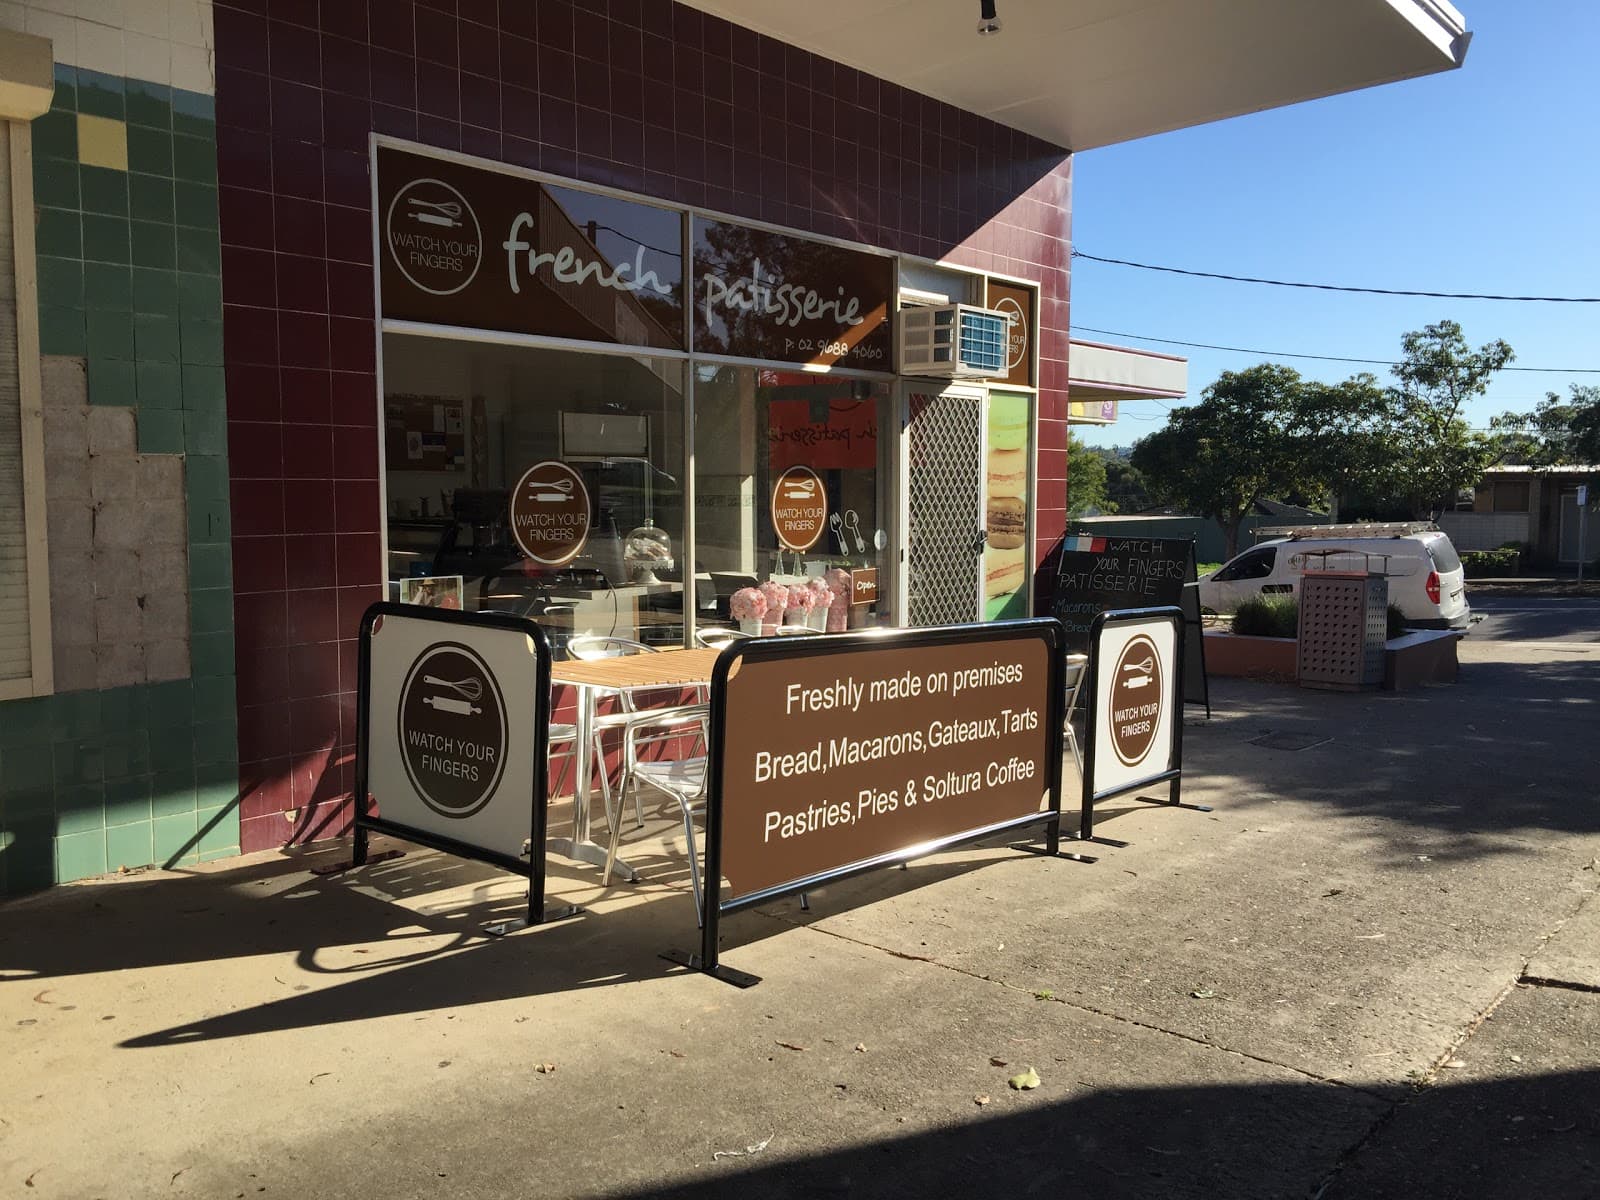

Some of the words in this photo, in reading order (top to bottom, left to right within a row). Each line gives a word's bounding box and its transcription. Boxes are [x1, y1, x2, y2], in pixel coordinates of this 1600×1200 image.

[393, 232, 440, 250] WATCH
[441, 238, 478, 258] YOUR
[410, 251, 464, 272] FINGERS
[503, 212, 672, 294] french
[702, 257, 864, 327] patisserie
[798, 338, 814, 350] 02
[818, 339, 848, 356] 9688
[852, 345, 883, 359] 4060
[1010, 334, 1025, 345] YOUR
[516, 513, 555, 527] WATCH
[556, 513, 587, 527] YOUR
[776, 508, 802, 519] WATCH
[803, 507, 824, 519] YOUR
[530, 528, 574, 541] FINGERS
[785, 520, 815, 531] FINGERS
[1109, 541, 1163, 553] WATCH
[1093, 557, 1121, 572] YOUR
[1128, 558, 1186, 580] FINGERS
[856, 580, 877, 594] Open
[1059, 573, 1161, 596] PATISSERIE
[786, 677, 864, 714] Freshly
[870, 670, 921, 703] made
[926, 672, 948, 693] on
[953, 661, 1023, 696] premises
[1115, 706, 1139, 723] WATCH
[1139, 702, 1158, 717] YOUR
[1121, 720, 1150, 738] FINGERS
[409, 729, 453, 753] WATCH
[456, 740, 495, 763] YOUR
[422, 754, 479, 782] FINGERS
[904, 780, 917, 806] &
[923, 772, 981, 802] Soltura
[986, 757, 1035, 788] Coffee
